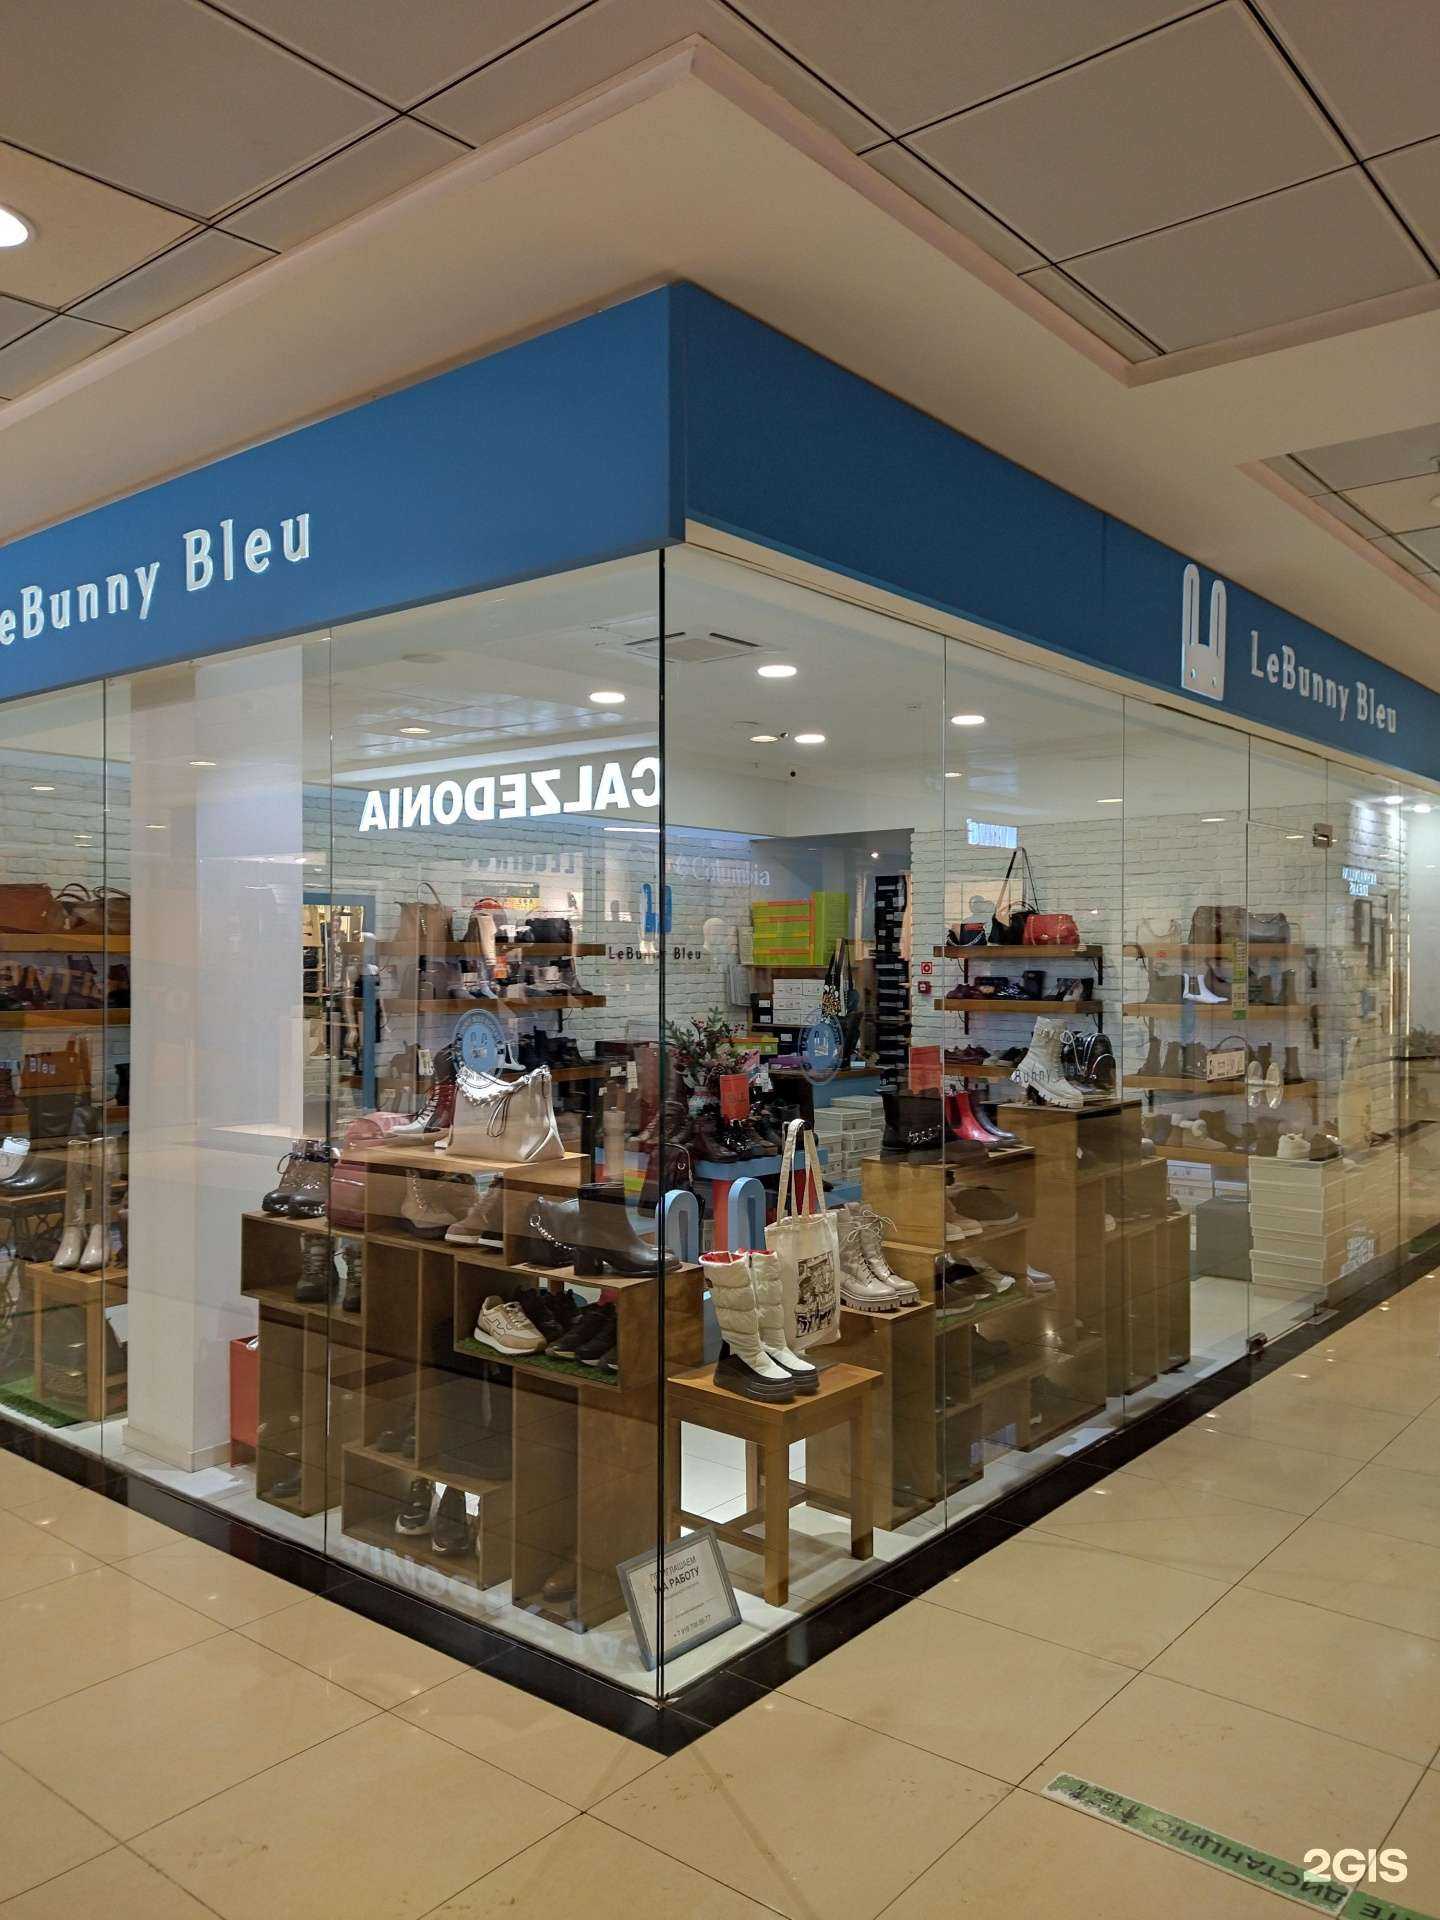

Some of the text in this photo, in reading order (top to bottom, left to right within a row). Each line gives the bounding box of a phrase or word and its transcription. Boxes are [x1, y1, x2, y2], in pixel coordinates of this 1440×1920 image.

[182, 513, 310, 592] Bleu
[1250, 630, 1397, 734] LeBunny Bleu
[673, 946, 702, 961] Bleu
[650, 1556, 697, 1584] ПГЛАШАЕМ
[669, 1567, 700, 1588] РАБОТУ
[1151, 1819, 1349, 1905] ДИСТАНЦИЮ
